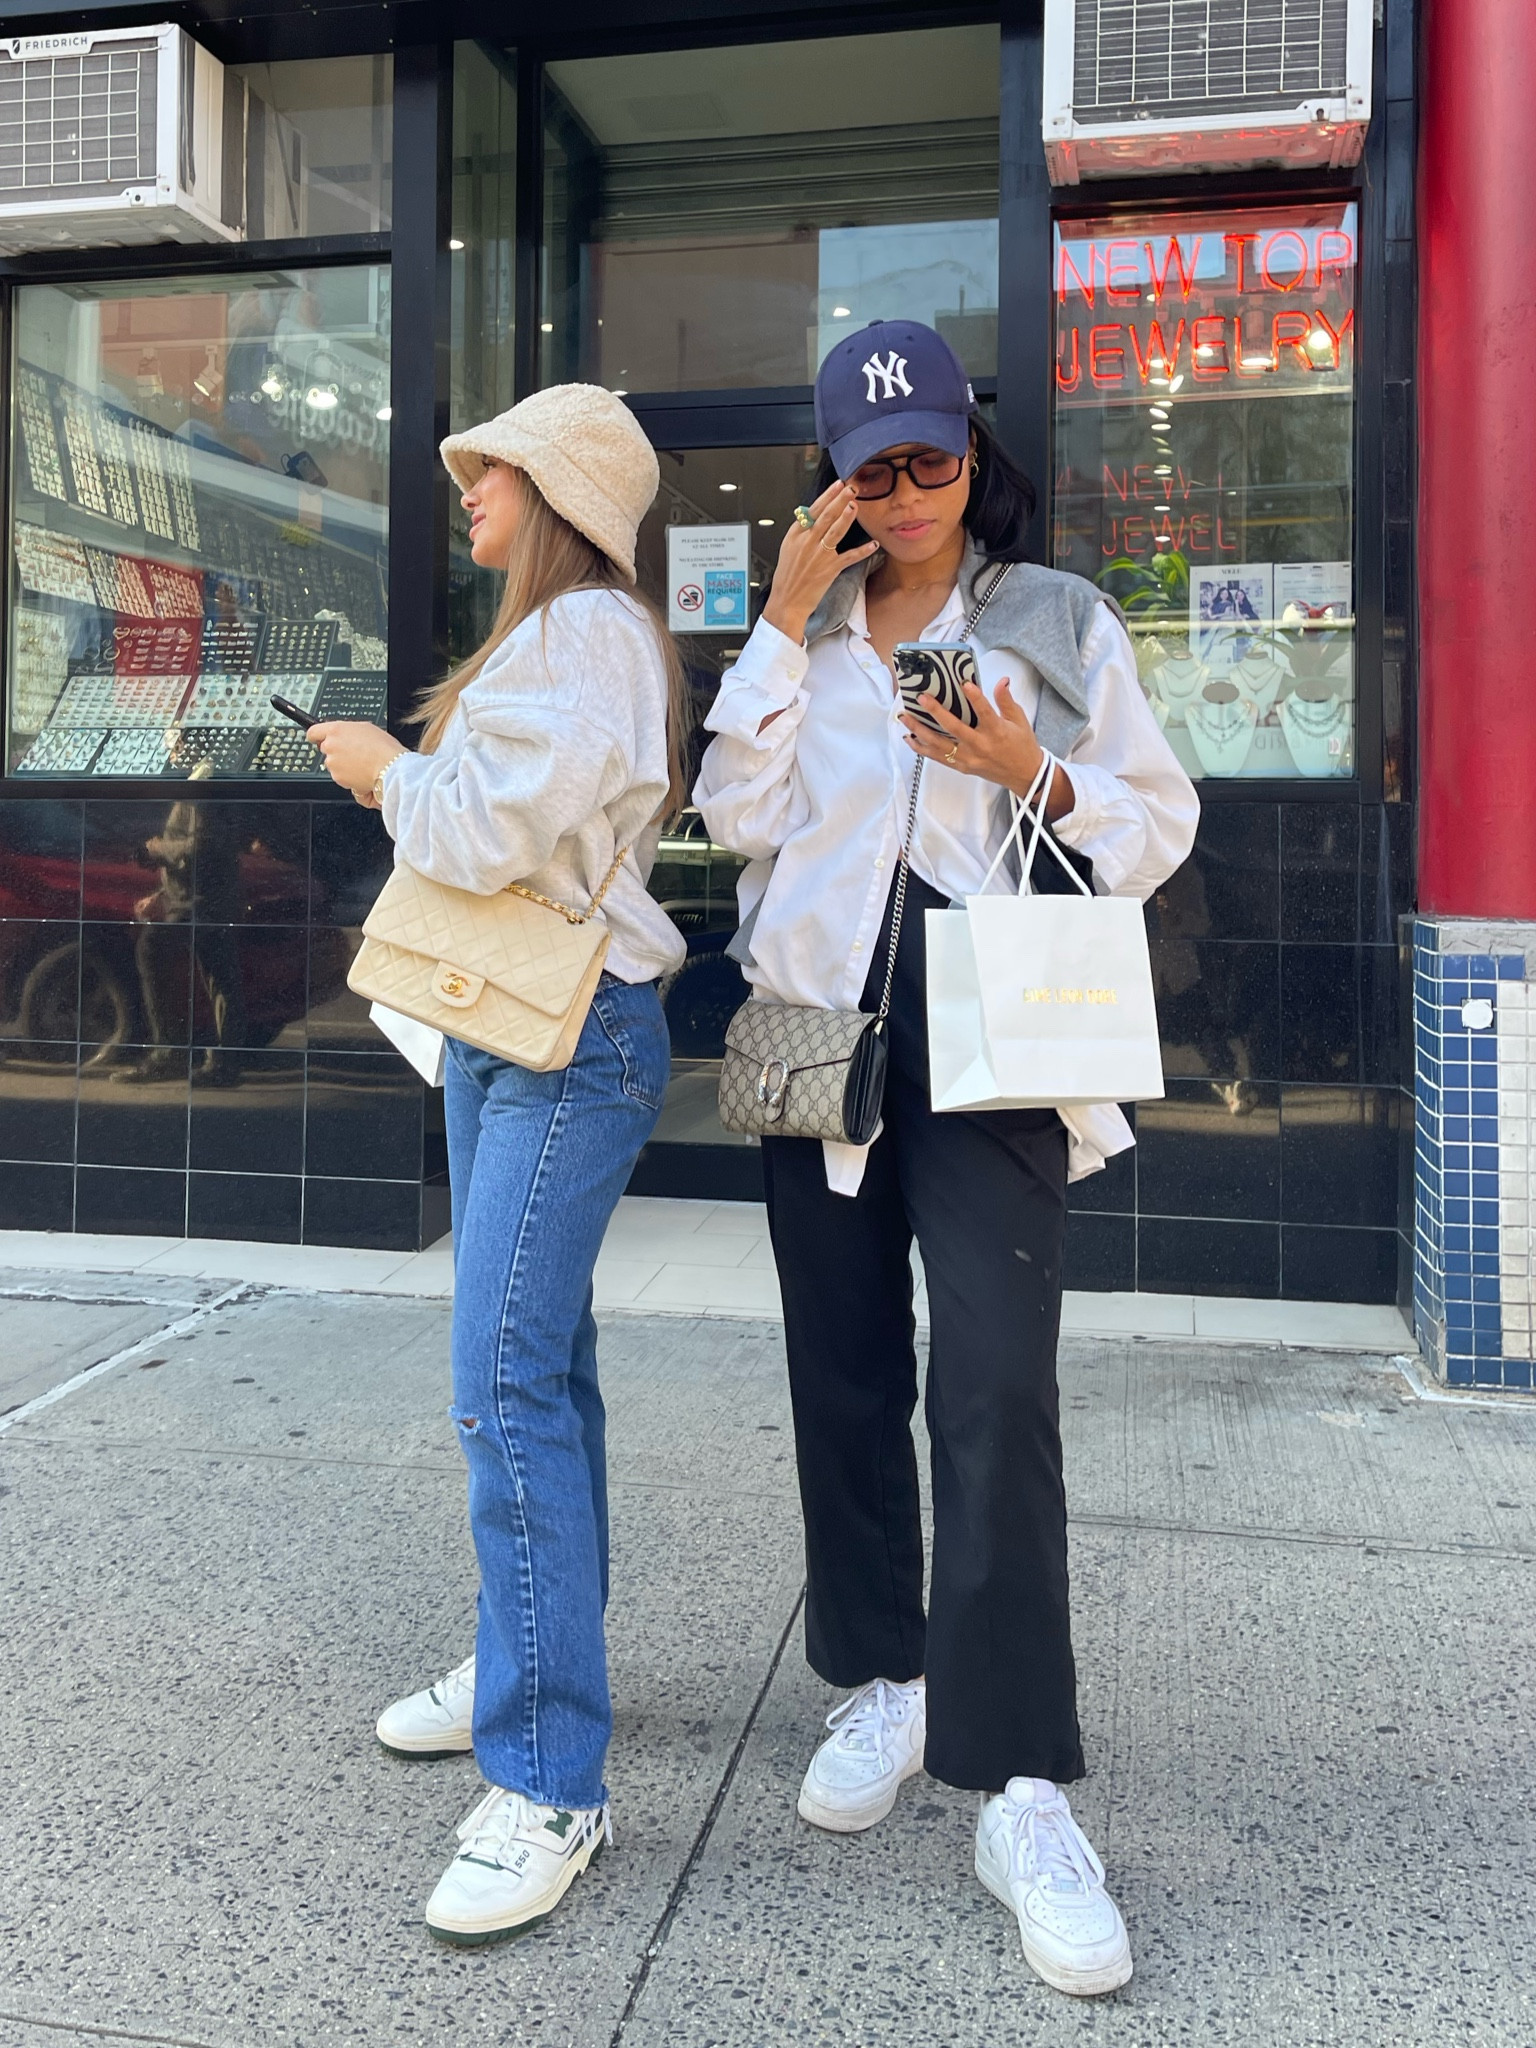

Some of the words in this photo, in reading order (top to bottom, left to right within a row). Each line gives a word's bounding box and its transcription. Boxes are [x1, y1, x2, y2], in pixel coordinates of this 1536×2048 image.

[25, 36, 88, 50] FRIEDRICH
[1059, 236, 1202, 307] NEW
[1222, 230, 1352, 293] TOP
[1056, 308, 1354, 384] JEWELRY
[861, 350, 914, 404] NY
[707, 579, 742, 587] MASKS
[707, 587, 742, 595] REQUIRED
[514, 1849, 530, 1869] 550
